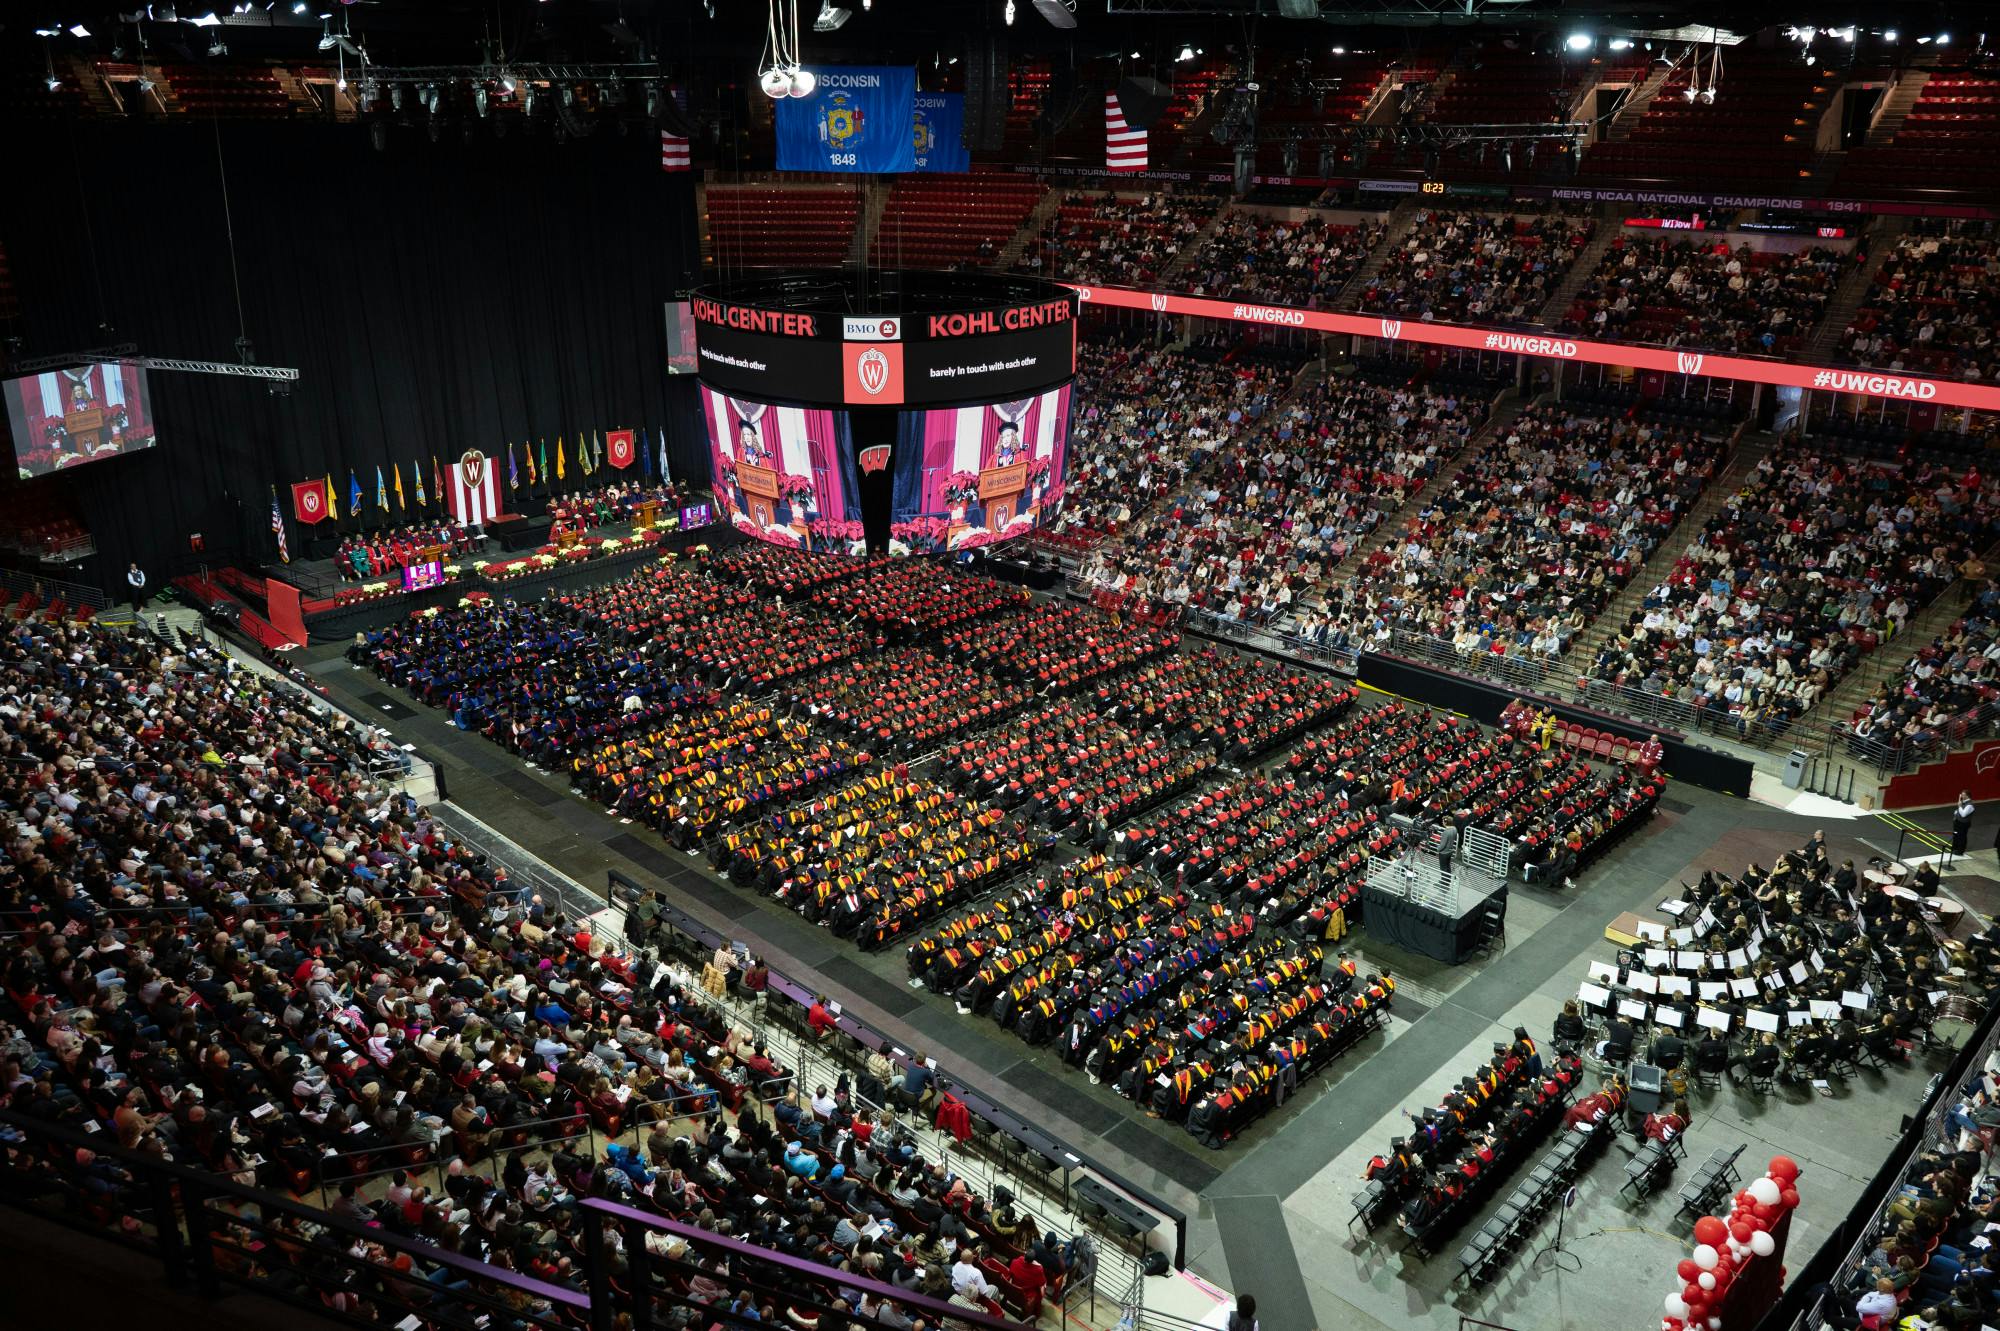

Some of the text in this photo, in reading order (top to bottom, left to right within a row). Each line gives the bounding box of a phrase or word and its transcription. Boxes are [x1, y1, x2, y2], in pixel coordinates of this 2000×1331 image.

[830, 154, 857, 166] 1848
[1058, 168, 1074, 176] TEN
[1138, 171, 1191, 181] CHAMPIONS
[1422, 183, 1444, 194] 10:23
[1552, 189, 1592, 200] MEN'S
[1596, 191, 1634, 202] NCAA
[1637, 193, 1706, 205] NATIONAL
[1713, 196, 1803, 210] CHAMPIONS
[693, 298, 816, 337] KOHL CENTER
[929, 300, 1070, 337] KOHL CENTER
[1233, 305, 1305, 325] #UWGRAD
[847, 324, 876, 334] BMO
[1485, 333, 1577, 357] #UWGRAD
[735, 359, 749, 368] each
[749, 361, 767, 371] other
[930, 368, 956, 378] barely
[967, 364, 988, 374] touch
[989, 361, 1004, 371] with
[1006, 359, 1020, 369] each
[1021, 356, 1037, 366] other
[865, 365, 881, 386] W
[1813, 371, 1936, 399] #UWGRAD
[466, 462, 480, 481] W
[987, 474, 1022, 487] WISCONSIN
